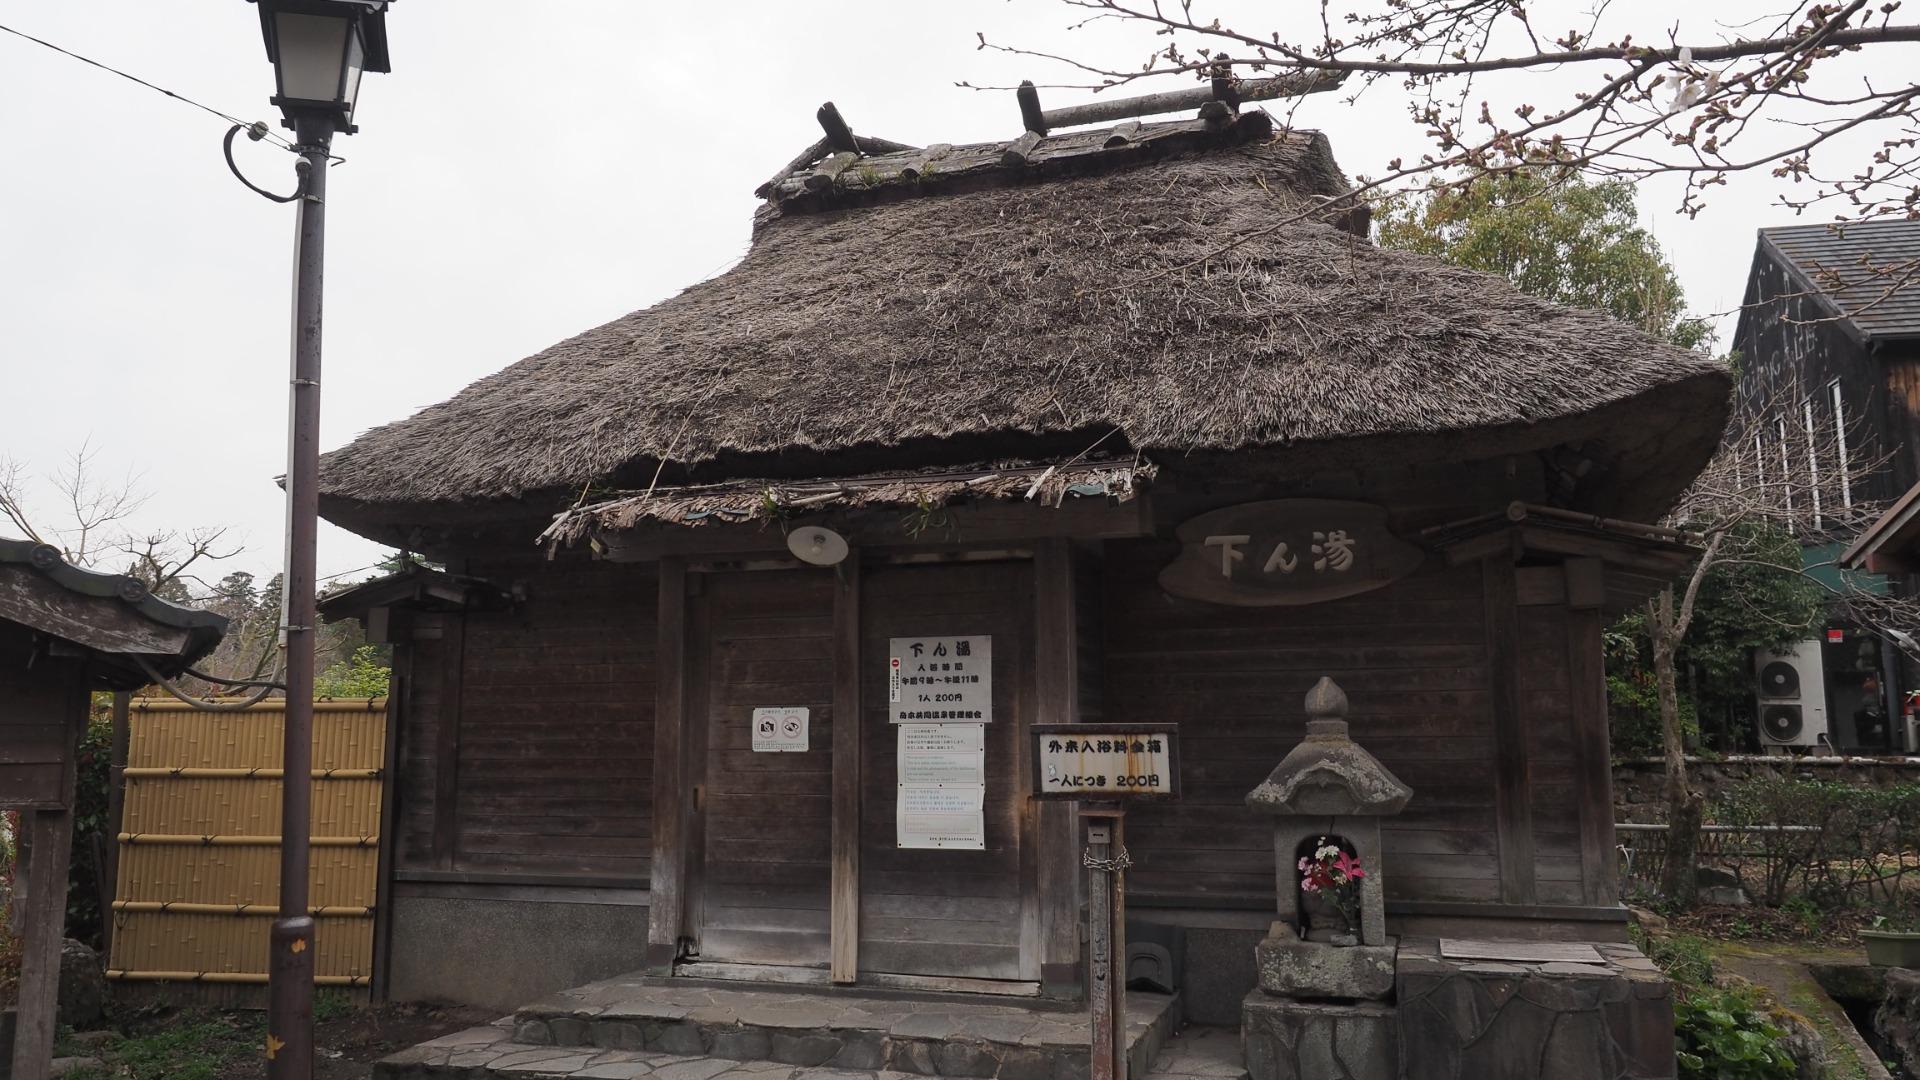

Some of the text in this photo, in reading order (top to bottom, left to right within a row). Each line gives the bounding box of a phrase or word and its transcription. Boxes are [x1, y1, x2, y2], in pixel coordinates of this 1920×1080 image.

[1204, 529, 1356, 579] 下ん湯
[910, 640, 970, 658] 下ん湯
[918, 663, 963, 672] 入浴時間
[1048, 739, 1162, 754] 外来入浴料金箱
[1048, 774, 1160, 787] 一人につき 200円
